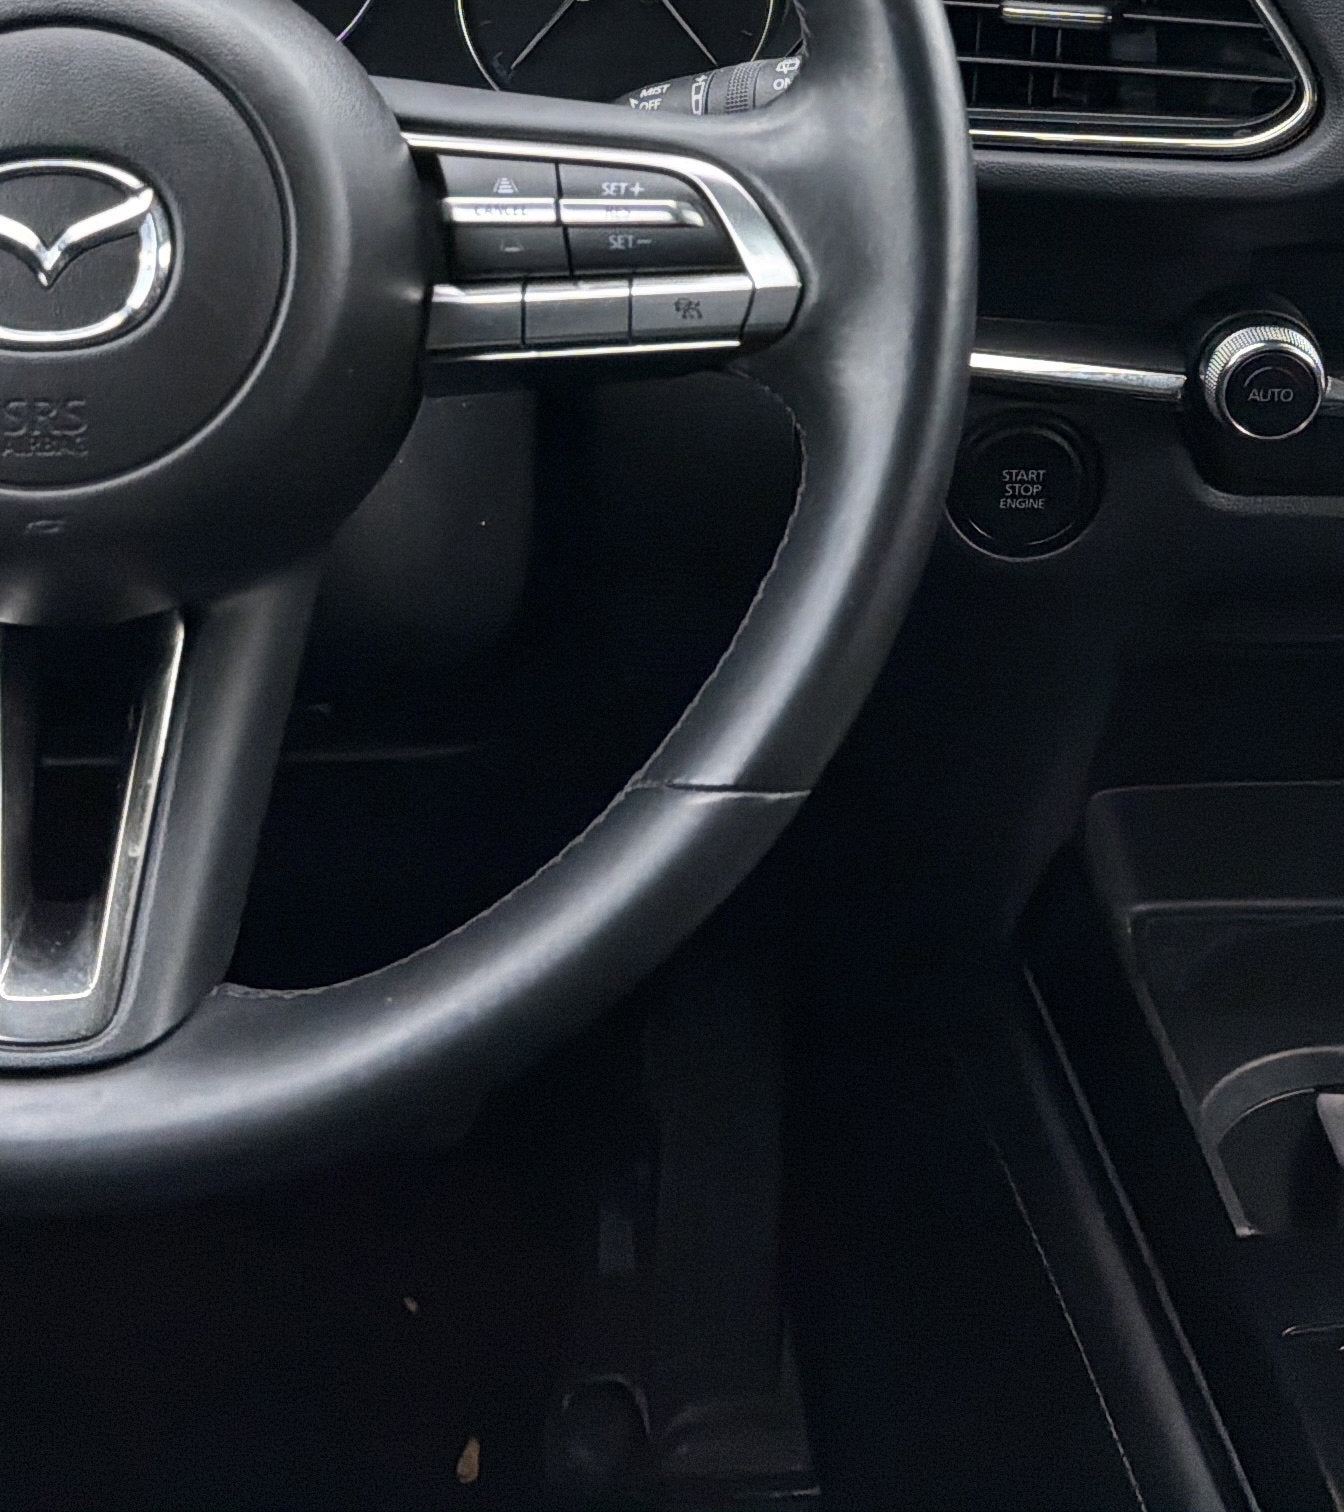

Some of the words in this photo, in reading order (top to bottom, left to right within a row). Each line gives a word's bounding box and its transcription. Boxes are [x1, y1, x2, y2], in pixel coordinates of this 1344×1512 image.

[640, 83, 672, 99] MIST
[1247, 388, 1295, 403] AUTO
[3, 399, 88, 437] SRS
[1001, 468, 1047, 483] START
[1004, 483, 1043, 497] STOP
[999, 498, 1046, 509] ENGINE
